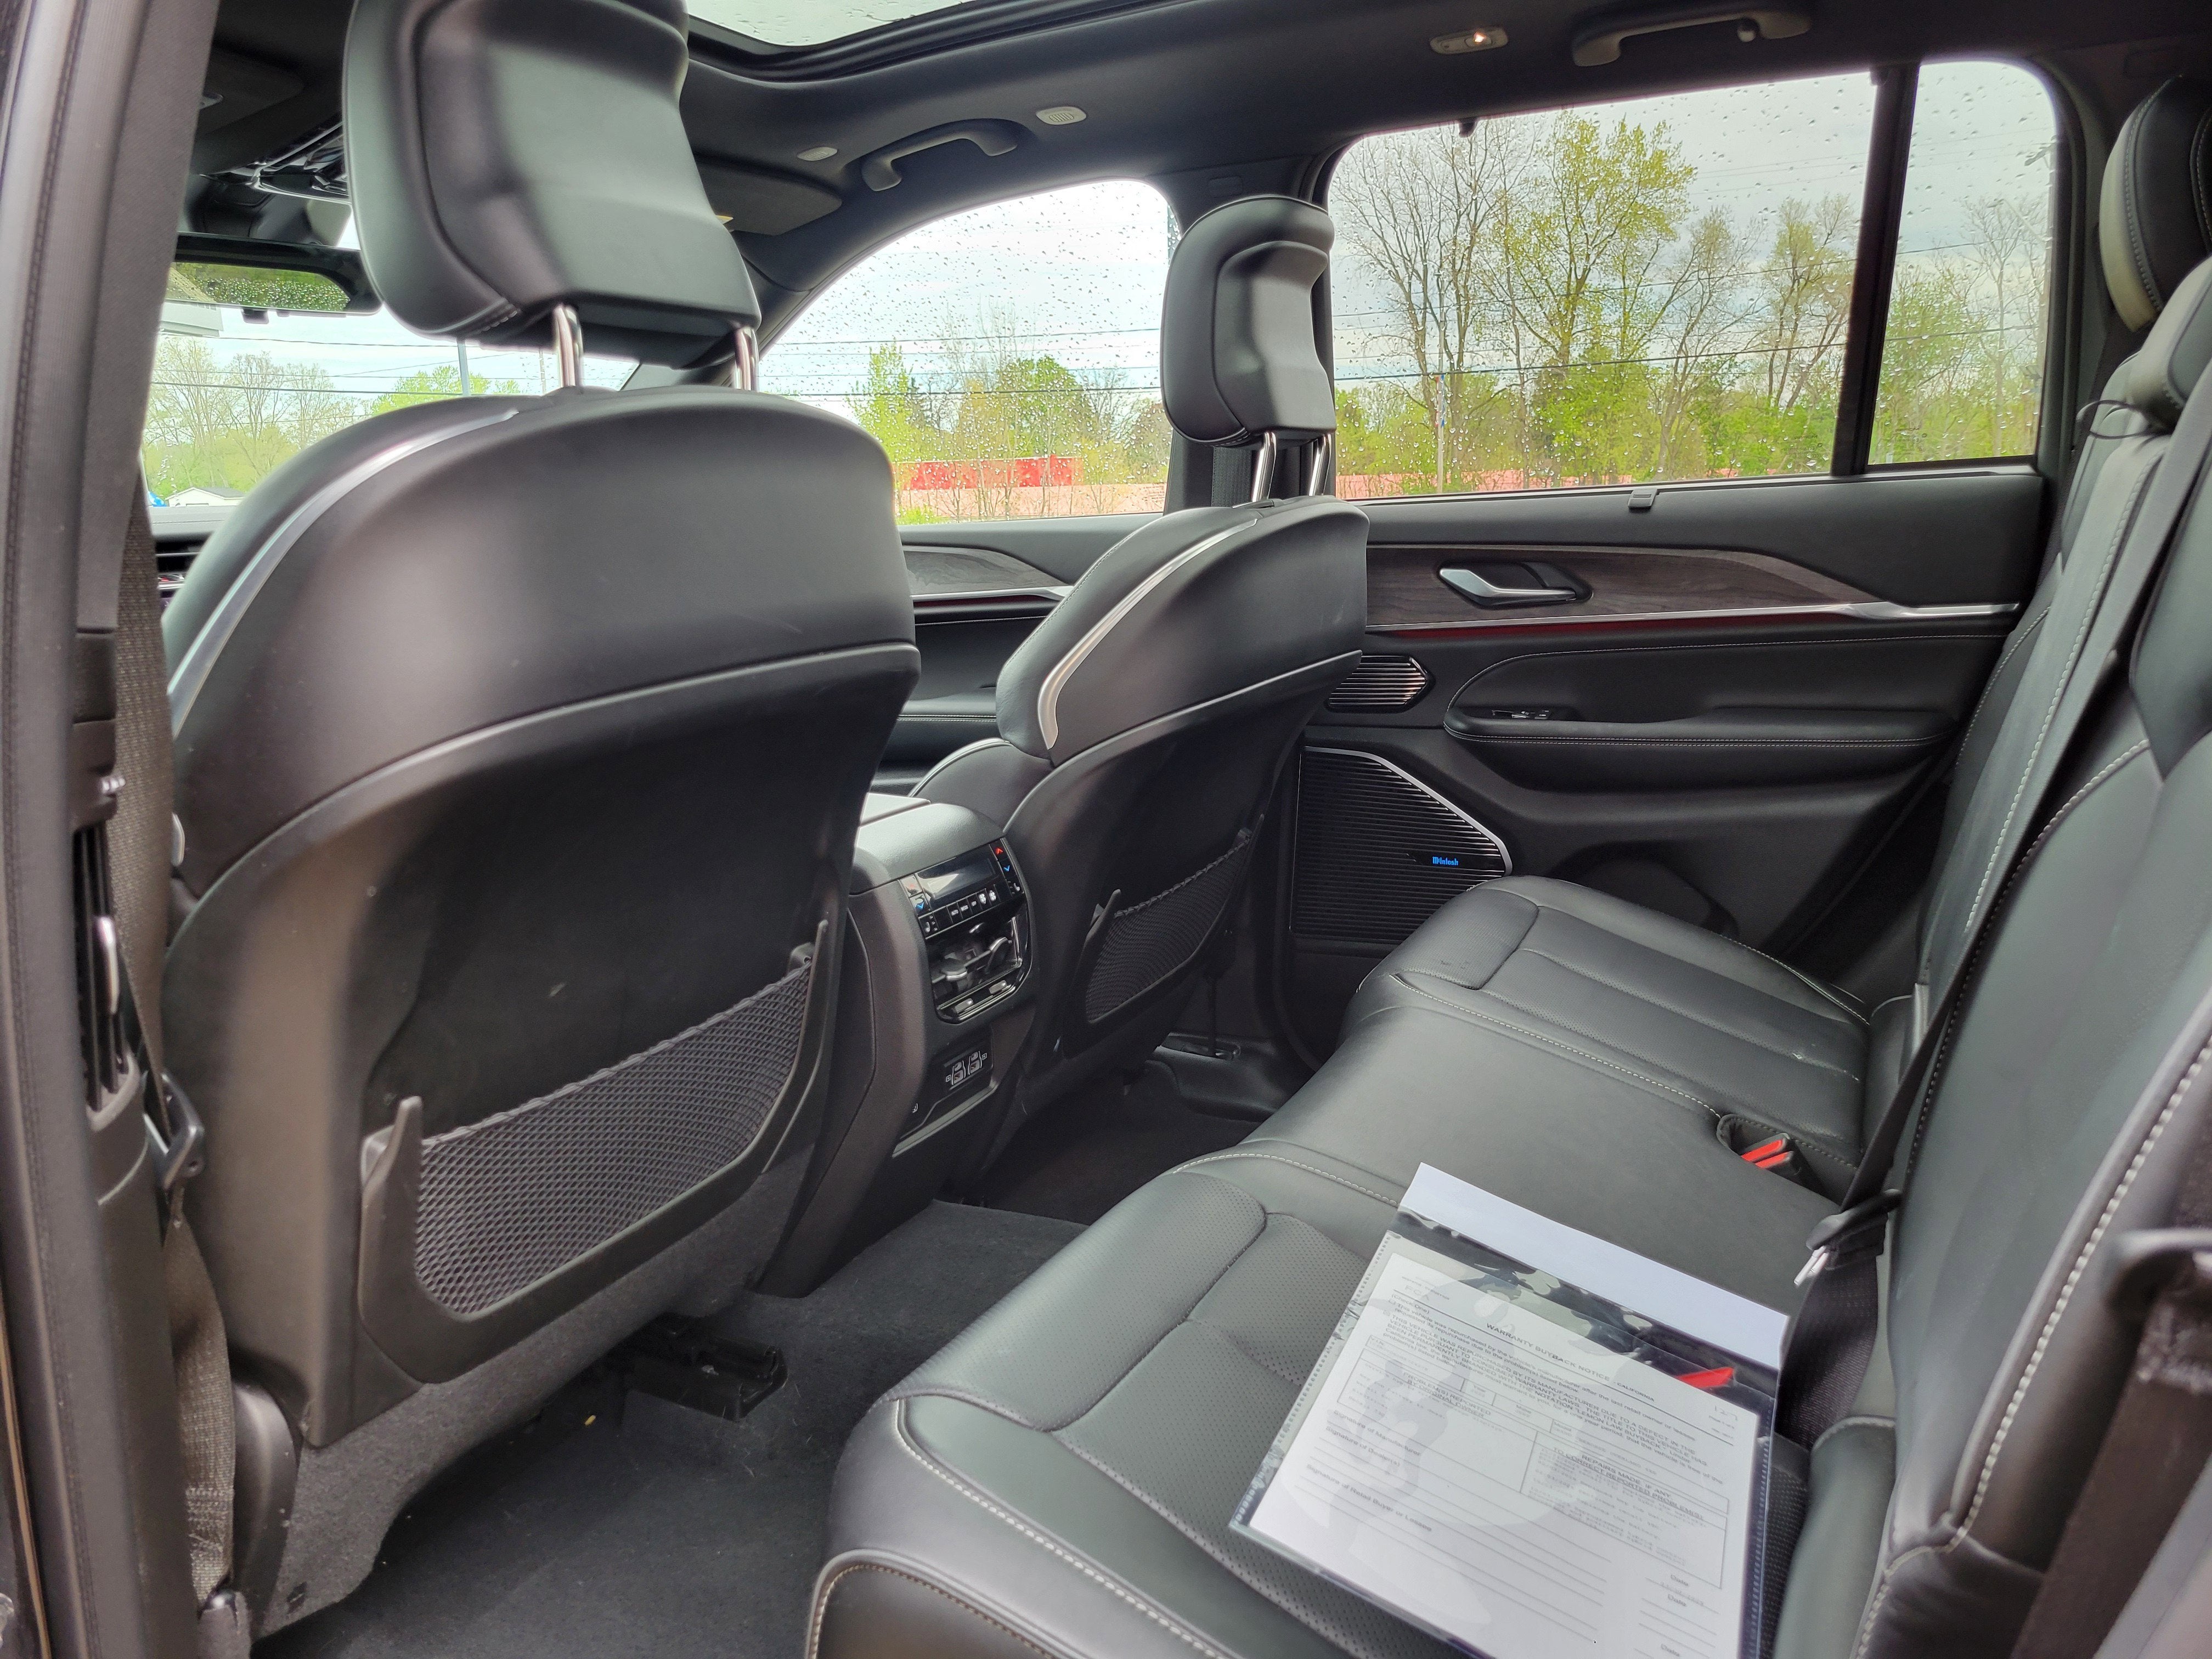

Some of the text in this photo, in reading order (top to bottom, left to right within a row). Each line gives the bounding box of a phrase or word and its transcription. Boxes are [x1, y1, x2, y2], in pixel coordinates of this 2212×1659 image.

[1413, 1304, 1430, 1314] One)
[1394, 1307, 1425, 1324] requested
[1434, 1326, 1470, 1345] repurchase
[1471, 1342, 1483, 1351] due
[1503, 1357, 1538, 1377] problem(s)
[1396, 1302, 1411, 1312] This
[1411, 1309, 1434, 1322] vehicle
[1433, 1320, 1447, 1329] was
[1447, 1326, 1487, 1347] repurchased
[1497, 1348, 1508, 1357] the
[1537, 1366, 1580, 1390] manufacturer
[1581, 1386, 1596, 1396] after
[1598, 1393, 1609, 1402] the
[1610, 1398, 1623, 1408] last
[1623, 1404, 1641, 1415] retail
[1641, 1413, 1662, 1425] owner
[1485, 1322, 1533, 1348] WARRANTY
[1534, 1345, 1577, 1368] BUYBACK
[1577, 1364, 1610, 1383] NOTICE
[1616, 1381, 1655, 1402] CALIFORNIA
[1387, 1323, 1407, 1335] BEEN
[1407, 1332, 1460, 1359] PERMANENTLY
[1461, 1356, 1497, 1376] BRANDED
[1498, 1373, 1517, 1385] WITH
[1519, 1383, 1533, 1392] THE
[1534, 1389, 1573, 1411] NOTATION
[1605, 1420, 1623, 1432] LAW
[1669, 1450, 1690, 1464] Under
[1389, 1318, 1419, 1335] VEHICLE
[1420, 1333, 1458, 1353] PURSUANT
[1460, 1351, 1470, 1359] TO
[1471, 1356, 1514, 1379] CONSUMER
[1514, 1375, 1556, 1398] WARRANTY
[1585, 1407, 1600, 1417] THE
[1603, 1414, 1623, 1426] TITLE
[1625, 1424, 1635, 1432] TO
[1638, 1429, 1655, 1441] THIS
[1656, 1438, 1690, 1458] VEHICLE
[1691, 1455, 1707, 1466] HAS
[1391, 1314, 1408, 1324] THIS
[1408, 1322, 1438, 1339] VEHICLE
[1438, 1336, 1456, 1347] WAS
[1457, 1344, 1511, 1373] REPURCHASED
[1524, 1375, 1536, 1384] ITS
[1537, 1379, 1599, 1412] MANUFACTURER
[1600, 1408, 1617, 1419] DUE
[1638, 1424, 1668, 1442] DEFECT
[1680, 1444, 1695, 1455] THE
[1403, 1371, 1449, 1396] PROBLEM(S)
[1449, 1392, 1491, 1417] REPORTED
[1407, 1379, 1417, 1387] BY
[1418, 1384, 1453, 1404] ORIGINAL
[1454, 1401, 1484, 1419] OWNER
[1441, 1353, 1483, 1376] manufacturer
[1485, 1373, 1502, 1384] must
[1503, 1381, 1527, 1396] warrant
[1569, 1411, 1582, 1420] one
[1583, 1417, 1598, 1427] year
[1626, 1435, 1639, 1444] that
[1640, 1442, 1652, 1451] the
[1654, 1448, 1678, 1463] vehicle
[1324, 1425, 1359, 1447] Signature
[1367, 1447, 1401, 1468] Dealer(s)
[1332, 1409, 1366, 1430] Signature
[1374, 1430, 1421, 1457] Manufacturer
[1553, 1446, 1564, 1455] TO
[1565, 1452, 1604, 1474] CORRECT
[1606, 1470, 1650, 1496] REPORTED
[1652, 1491, 1702, 1520] PROBLEM(S)
[1581, 1453, 1616, 1474] REPAIRS
[1305, 1463, 1341, 1486] Signature
[1341, 1481, 1350, 1490] of
[1350, 1486, 1372, 1502] Retail
[1372, 1497, 1395, 1514] Buyer
[1404, 1514, 1432, 1533] Lessee
[1667, 1593, 1686, 1608] Date
[1669, 1573, 1689, 1588] Date
[1660, 1642, 1680, 1658] Date
